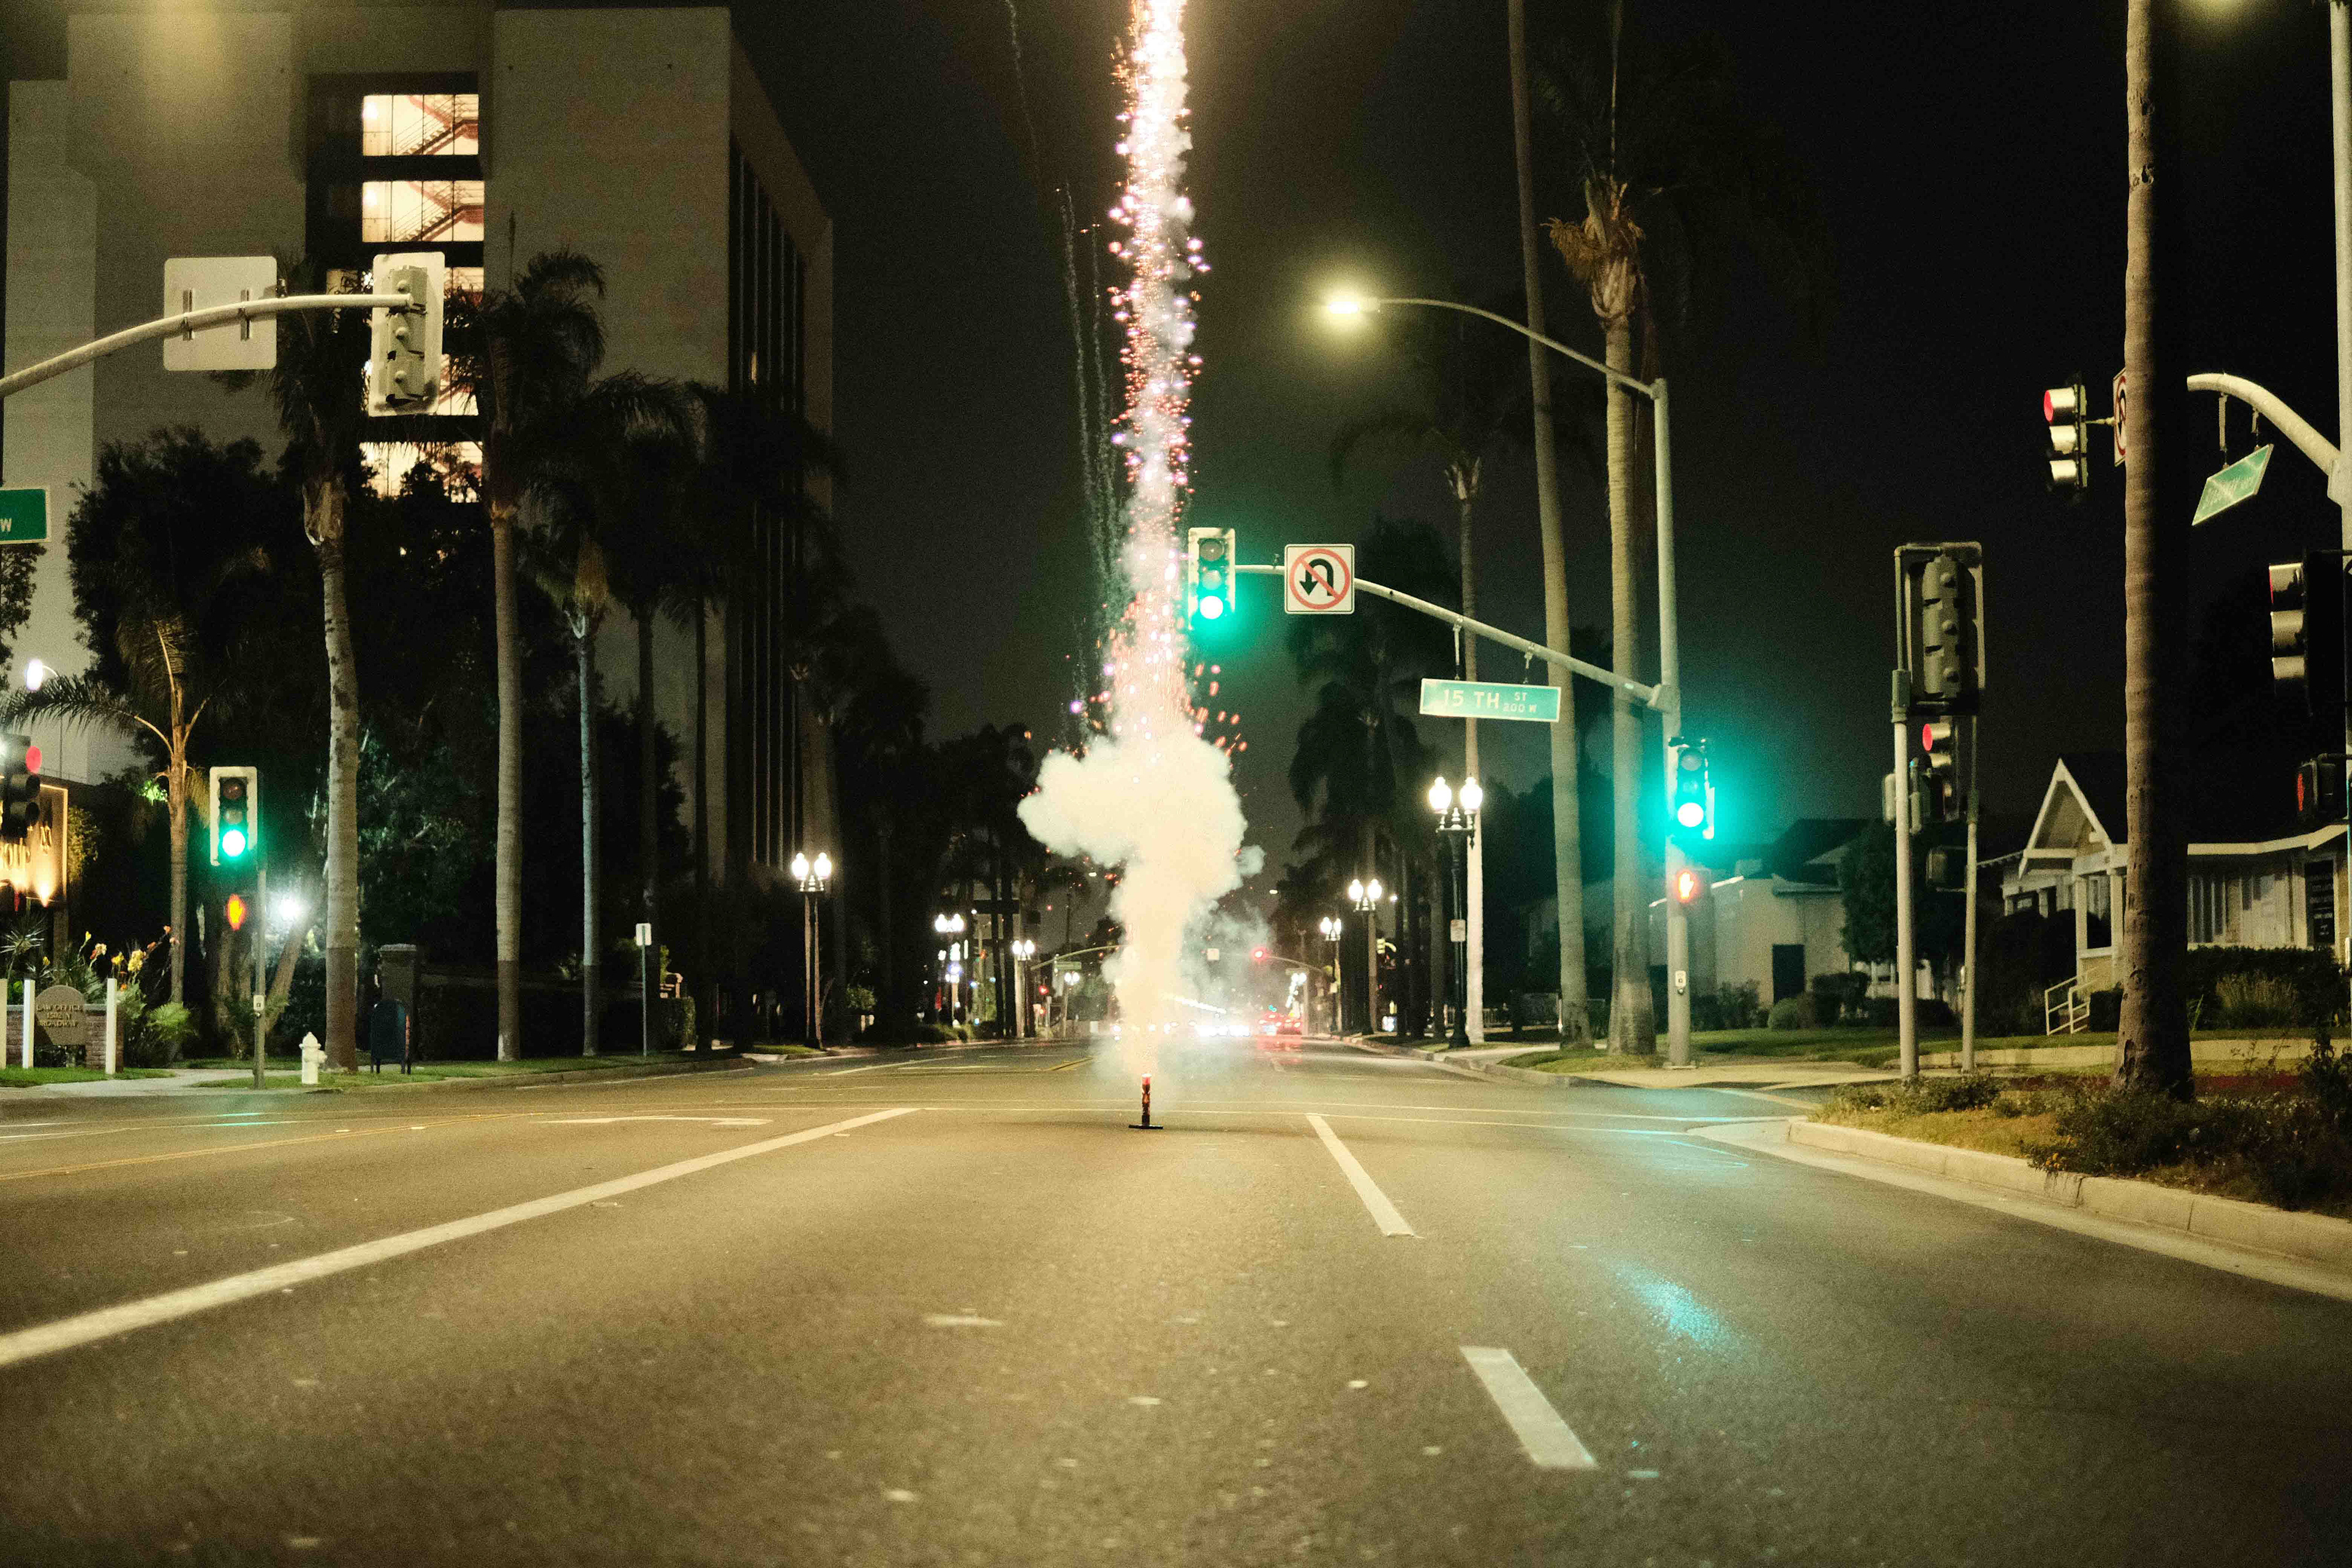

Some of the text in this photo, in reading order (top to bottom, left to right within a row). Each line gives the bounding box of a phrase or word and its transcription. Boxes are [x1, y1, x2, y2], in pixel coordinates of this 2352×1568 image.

[0, 518, 12, 532] W
[1443, 689, 1528, 709] 15 TH ST
